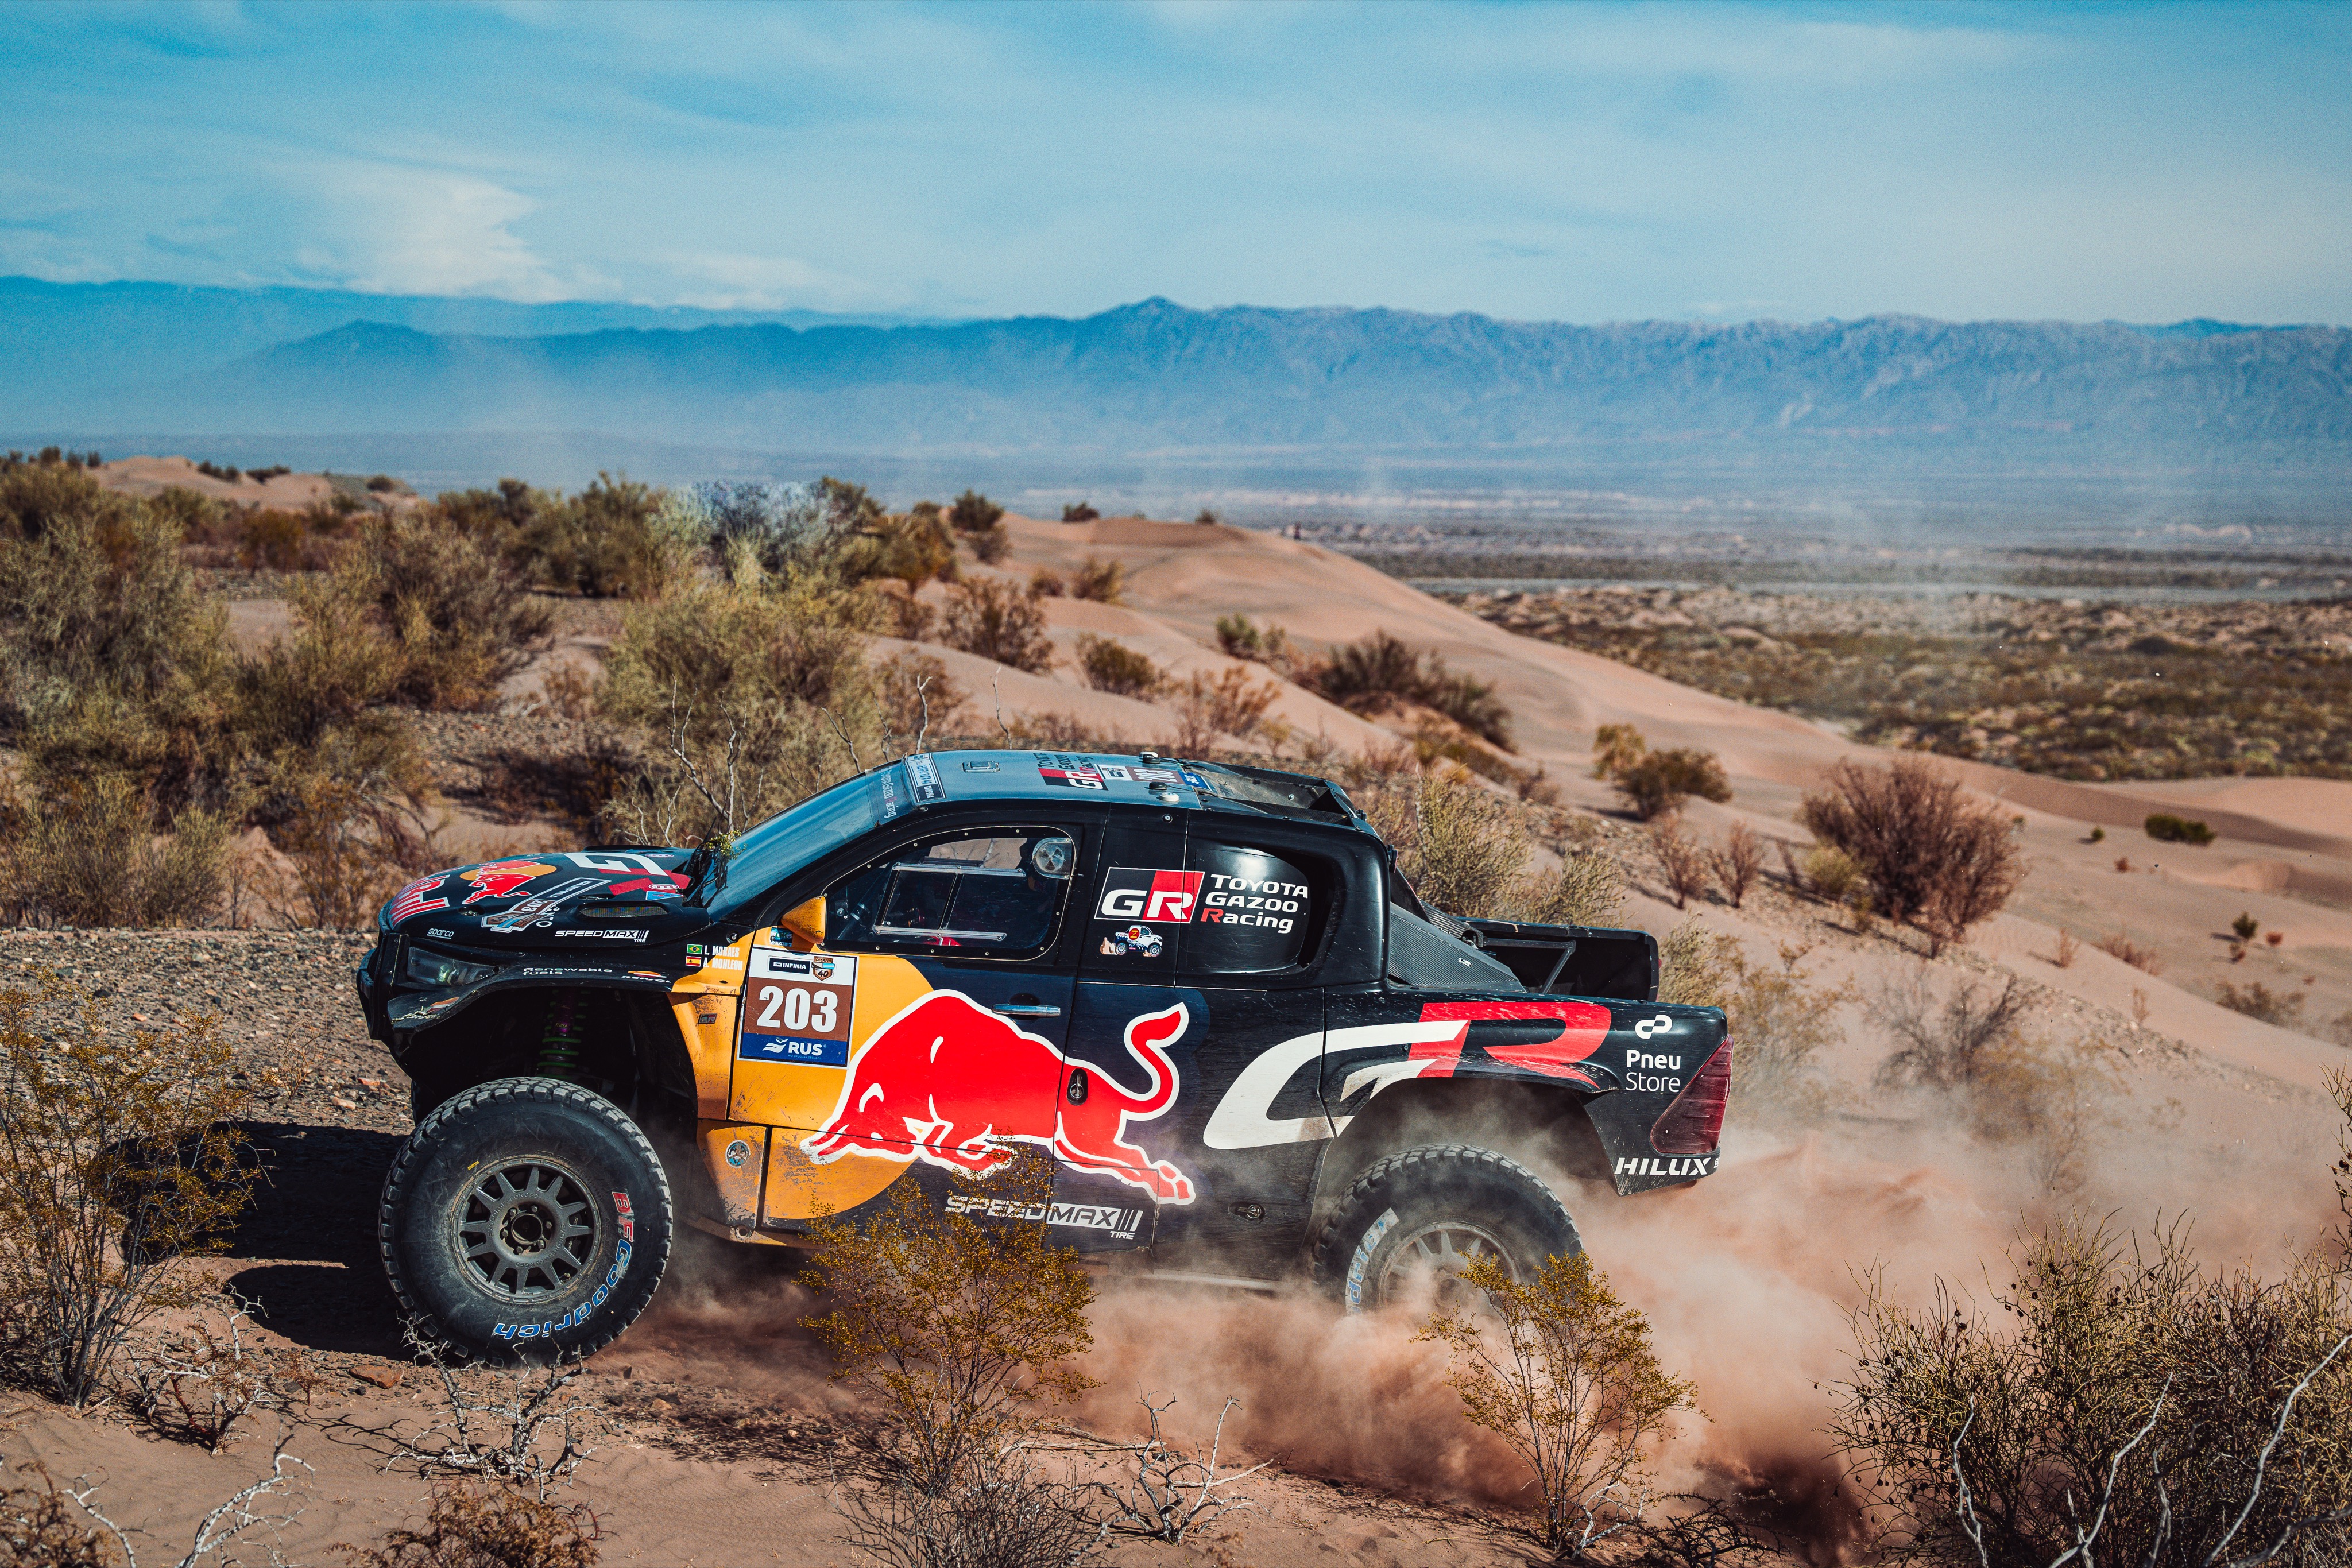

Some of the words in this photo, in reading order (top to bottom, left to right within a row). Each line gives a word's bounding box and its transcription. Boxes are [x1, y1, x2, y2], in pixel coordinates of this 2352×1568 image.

[1054, 754, 1075, 770] GAZOO
[1076, 756, 1096, 773] Racing
[1064, 770, 1104, 790] GR
[1132, 768, 1179, 783] 203
[1210, 874, 1309, 899] TOYOTA
[525, 899, 548, 912] 203
[1101, 889, 1194, 919] GR
[1205, 892, 1299, 913] GAZOO
[1201, 908, 1294, 934] Racing
[427, 928, 454, 938] sparco
[705, 945, 710, 955] L.
[712, 946, 740, 958] MORAES
[703, 957, 710, 968] A.
[712, 958, 743, 971] MONLEON
[621, 975, 672, 984] REPSOL
[756, 985, 838, 1033] 203
[788, 1041, 823, 1056] RUS
[1626, 1050, 1681, 1070] Pneu
[1626, 1072, 1681, 1092] Store
[1614, 1157, 1711, 1176] HILUX
[1110, 1230, 1135, 1240] TIRE
